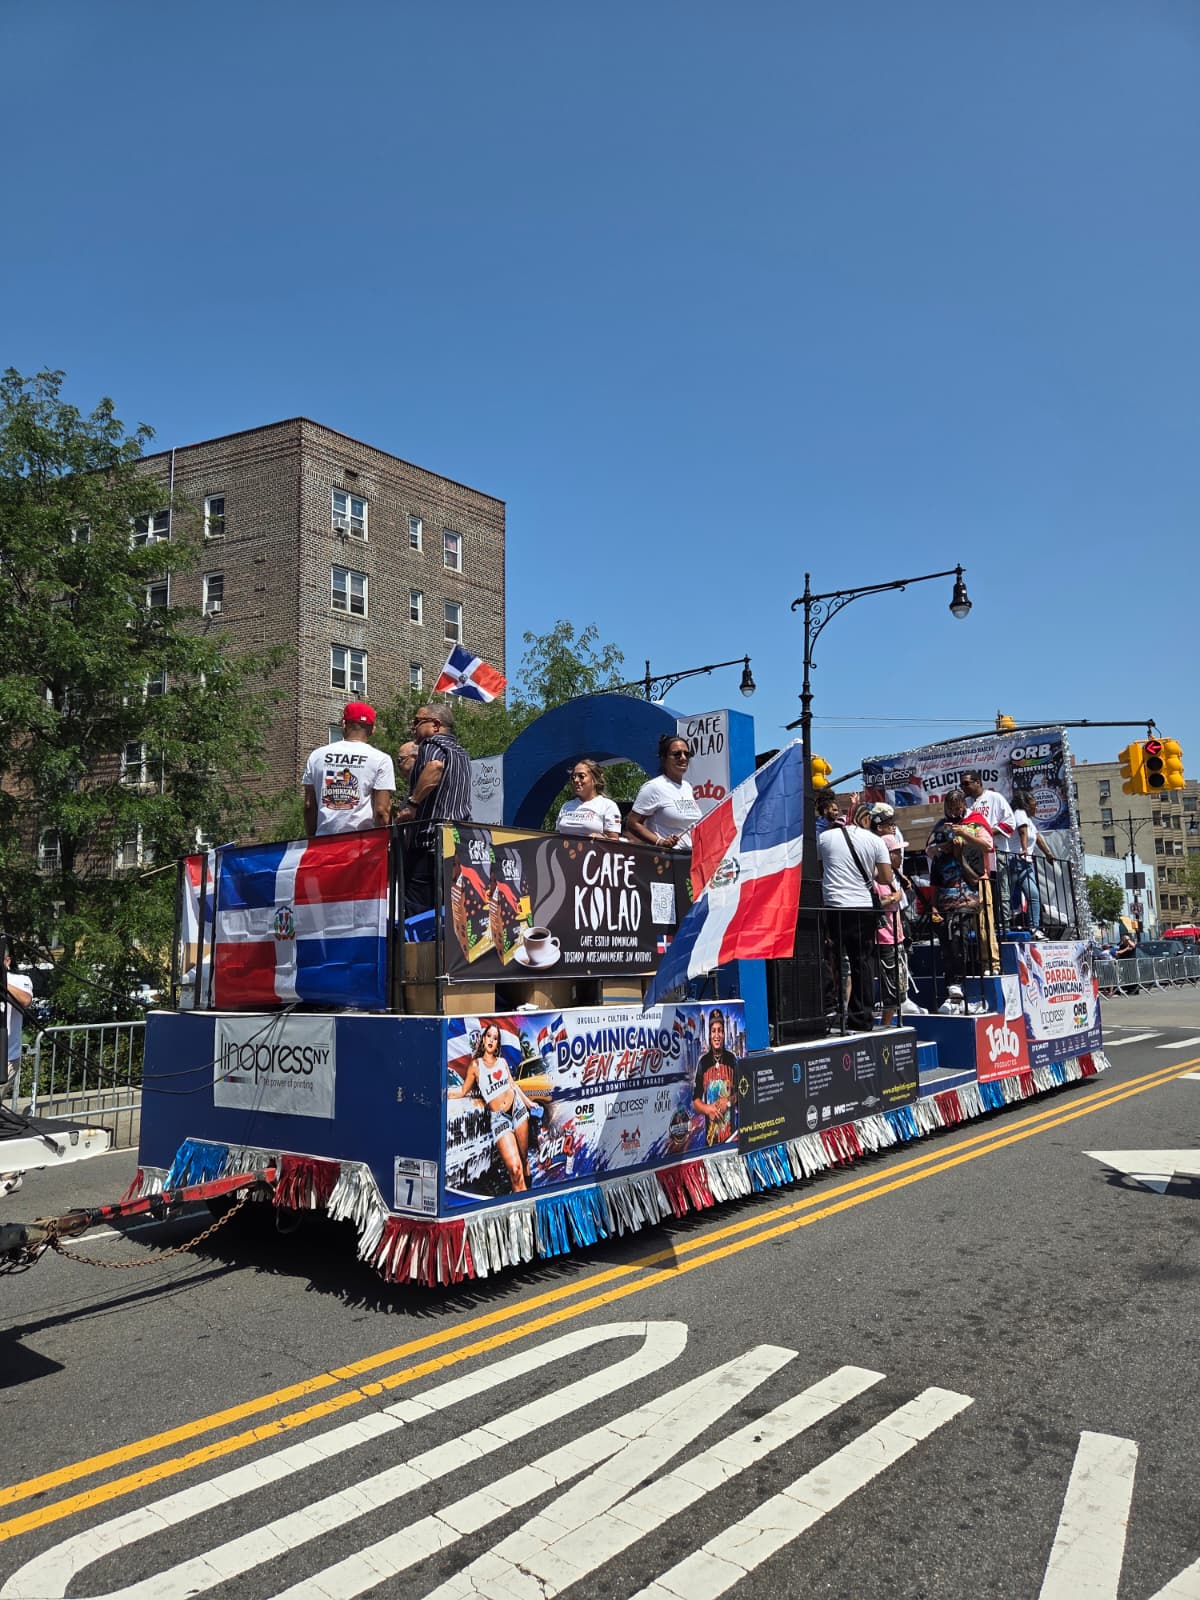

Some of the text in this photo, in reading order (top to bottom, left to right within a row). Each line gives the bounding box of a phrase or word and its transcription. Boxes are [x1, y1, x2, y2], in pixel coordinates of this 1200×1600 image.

[687, 716, 721, 737] CAFÉ
[687, 733, 724, 757] OLAO
[1010, 743, 1052, 760] ORB
[324, 753, 368, 765] STAFF
[1012, 763, 1055, 774] PRINTING
[922, 769, 999, 792] FELICITOS
[693, 779, 726, 800] ato
[582, 850, 638, 888] CAFÉ
[574, 886, 642, 932] KOLAO
[1045, 968, 1078, 984] PARADA
[1043, 982, 1083, 998] DOMINICANA
[1073, 1002, 1088, 1015] ORB
[577, 1016, 600, 1025] ORGULLO
[607, 1014, 629, 1023] CULTURA
[557, 1025, 681, 1072] DOMINICANOS
[582, 1047, 664, 1085] EN ALTO
[270, 1079, 287, 1089] power
[293, 1080, 313, 1092] printing
[487, 1074, 492, 1084] I
[581, 1086, 602, 1097] BRONX
[605, 1079, 641, 1092] DOMINICAN
[575, 1103, 595, 1116] ORB
[405, 1178, 414, 1206] 7
